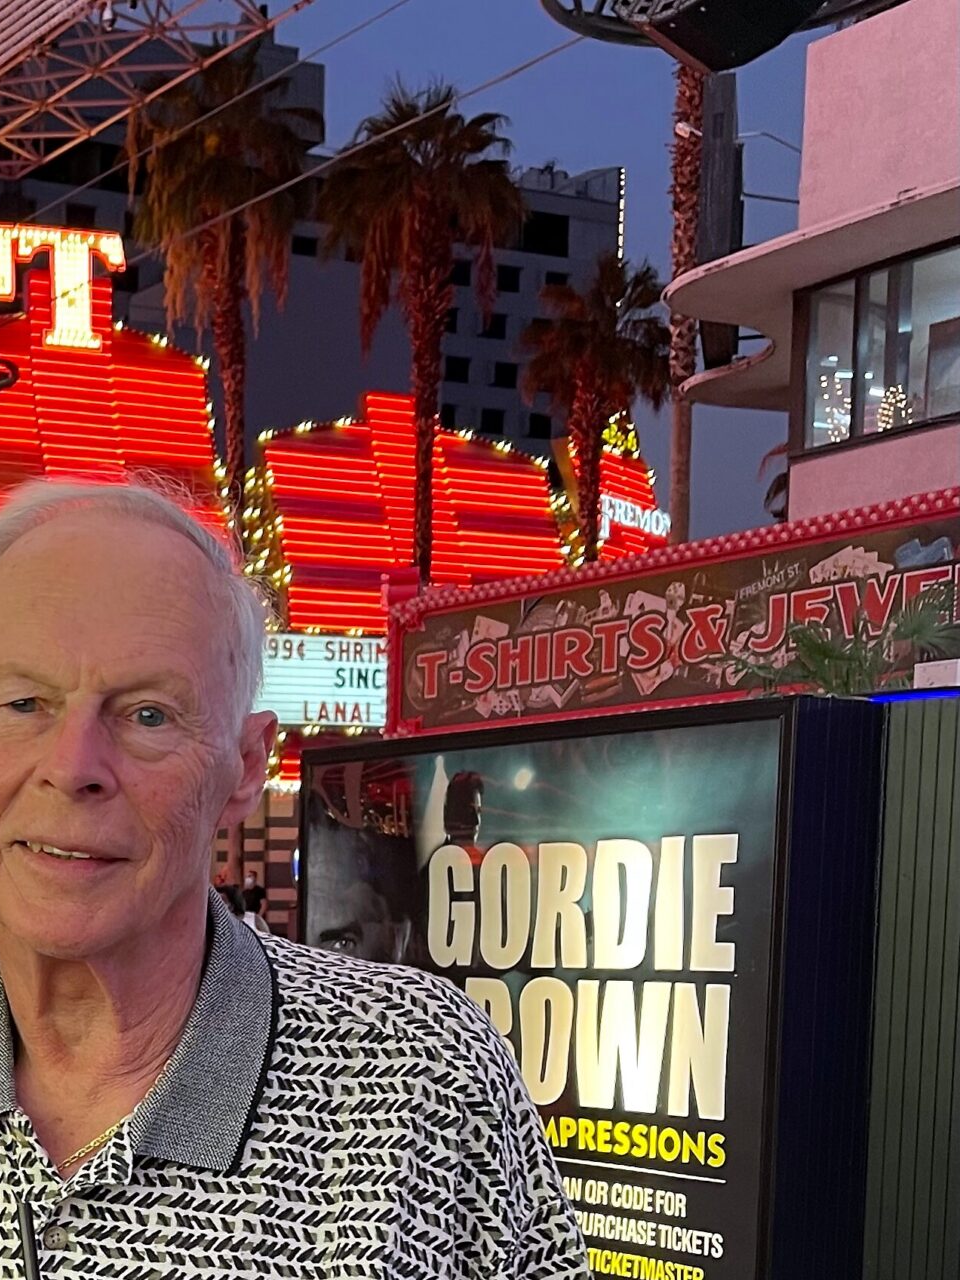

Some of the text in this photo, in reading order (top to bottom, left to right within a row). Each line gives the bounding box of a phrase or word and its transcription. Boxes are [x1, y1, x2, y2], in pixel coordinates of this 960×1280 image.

[416, 612, 666, 699] T-SHIRTS
[681, 604, 729, 662] &
[302, 700, 371, 723] LANAI
[427, 833, 739, 972] GORDIE
[584, 1179, 608, 1207] QR
[611, 1184, 653, 1212] CODE
[656, 1191, 687, 1218] FOR
[658, 1224, 724, 1259] TICKETS
